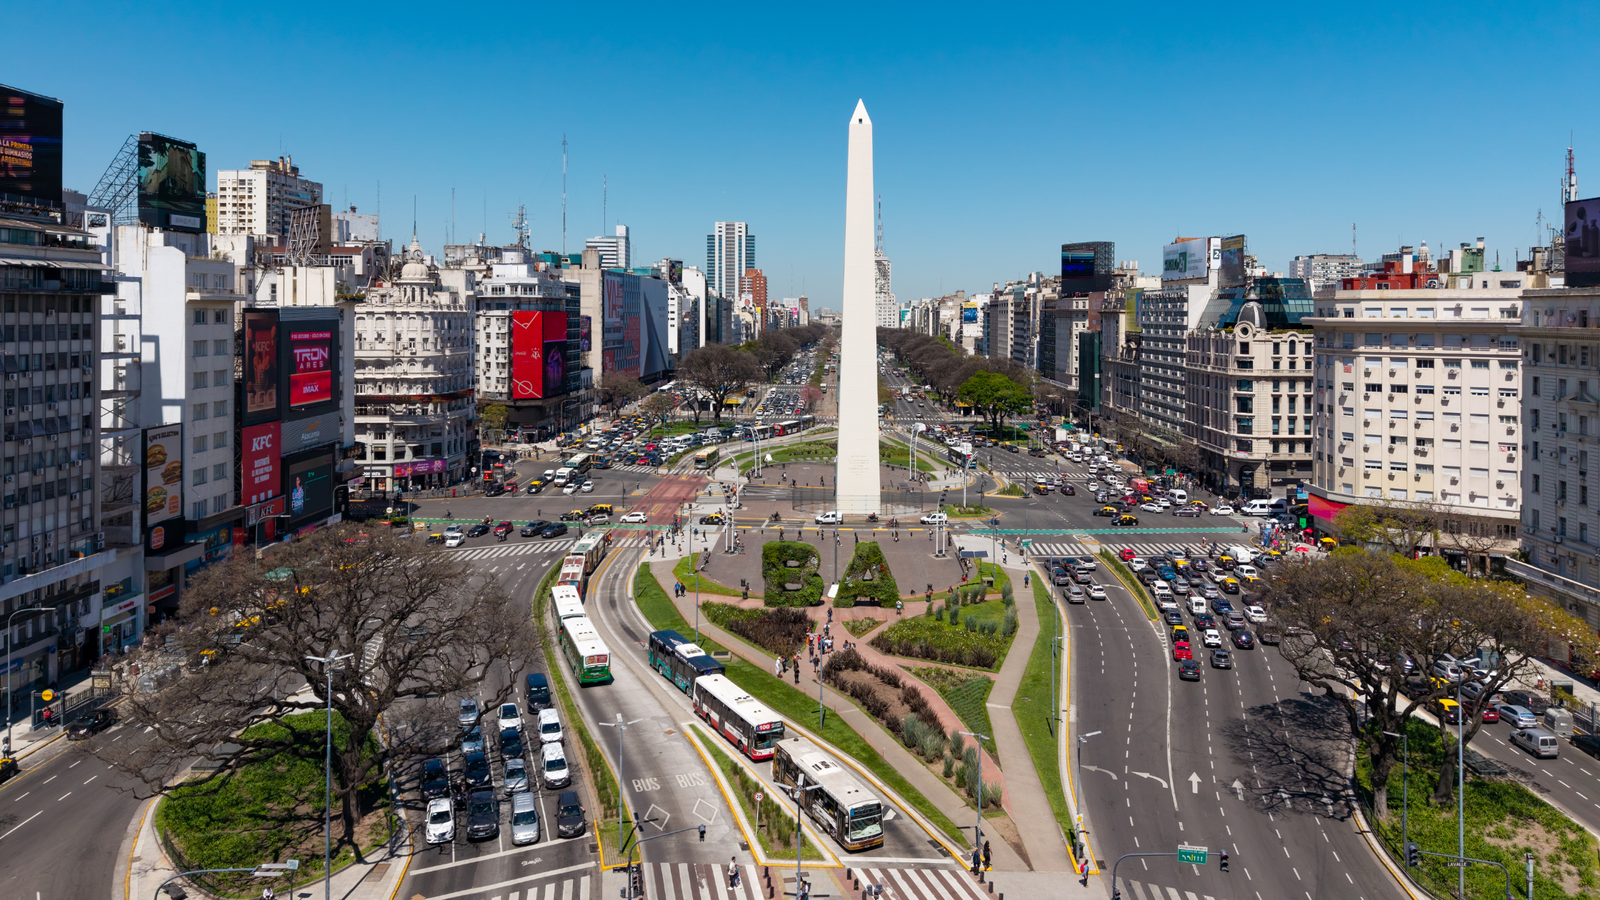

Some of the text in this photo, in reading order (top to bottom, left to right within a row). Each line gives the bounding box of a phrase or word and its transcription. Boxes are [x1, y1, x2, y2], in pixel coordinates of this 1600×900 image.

[10, 141, 33, 152] PRIMERA
[4, 148, 33, 160] GIMNASIOS
[255, 341, 270, 352] KFC
[294, 347, 328, 362] TRON
[300, 361, 323, 369] ARES
[303, 385, 319, 394] IMAX
[252, 434, 272, 452] KFC
[260, 504, 274, 517] KFC
[632, 778, 660, 792] BUS
[676, 772, 704, 788] BUS
